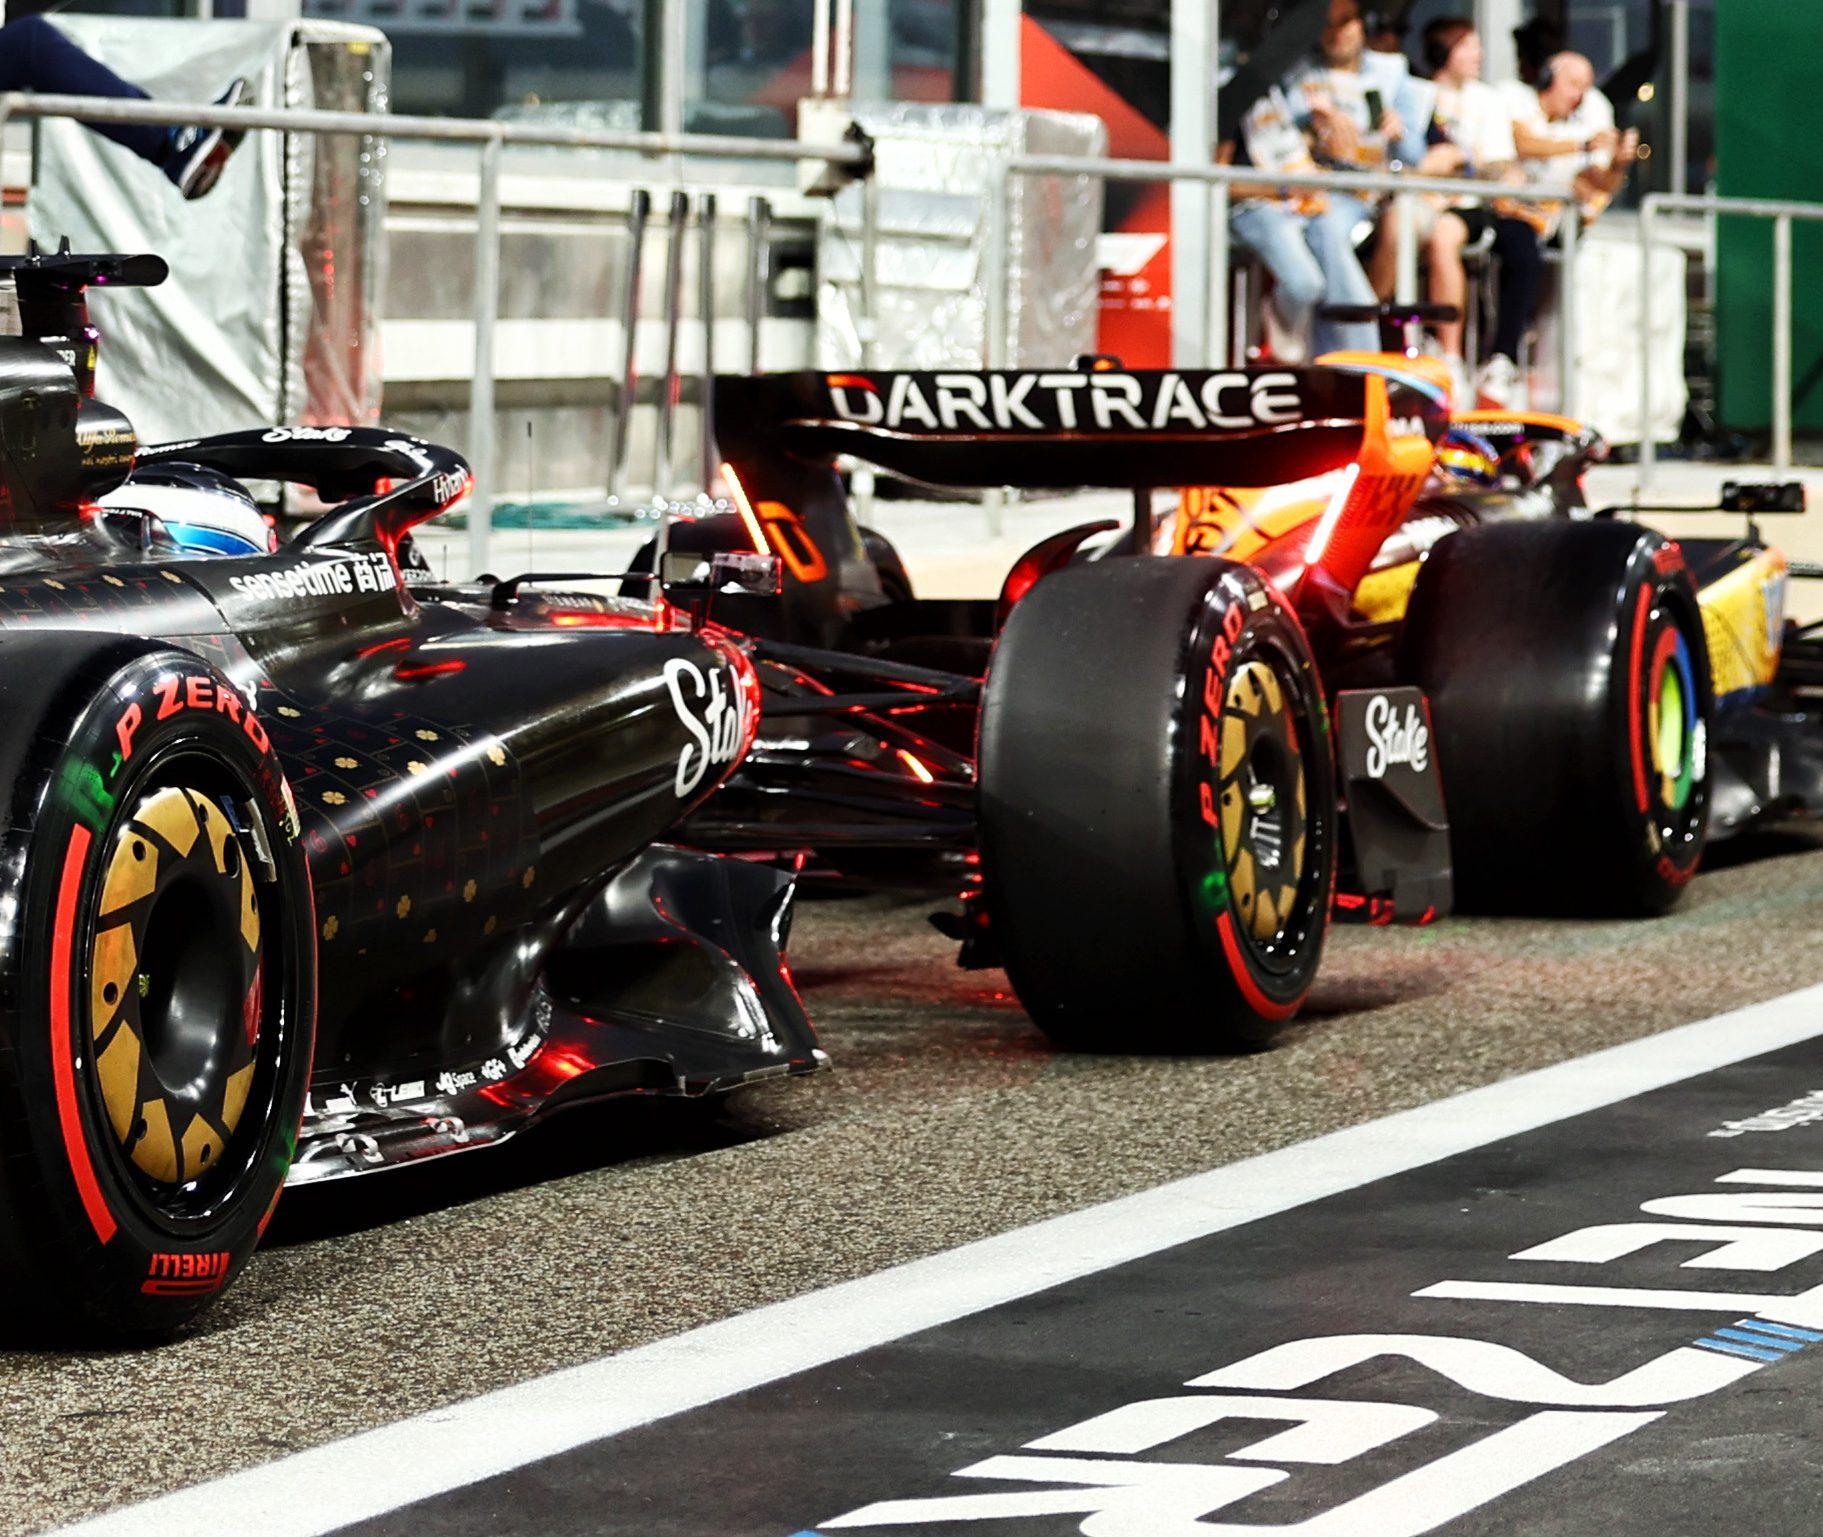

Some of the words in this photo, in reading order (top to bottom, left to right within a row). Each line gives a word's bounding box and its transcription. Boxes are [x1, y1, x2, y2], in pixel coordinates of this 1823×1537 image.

[827, 372, 1302, 429] DARKTRACE
[229, 558, 353, 602] sensetime
[152, 671, 271, 755] ZERO
[1201, 602, 1245, 767] ZERO
[1365, 694, 1429, 779] Stake
[141, 1252, 231, 1295] PIRELLI
